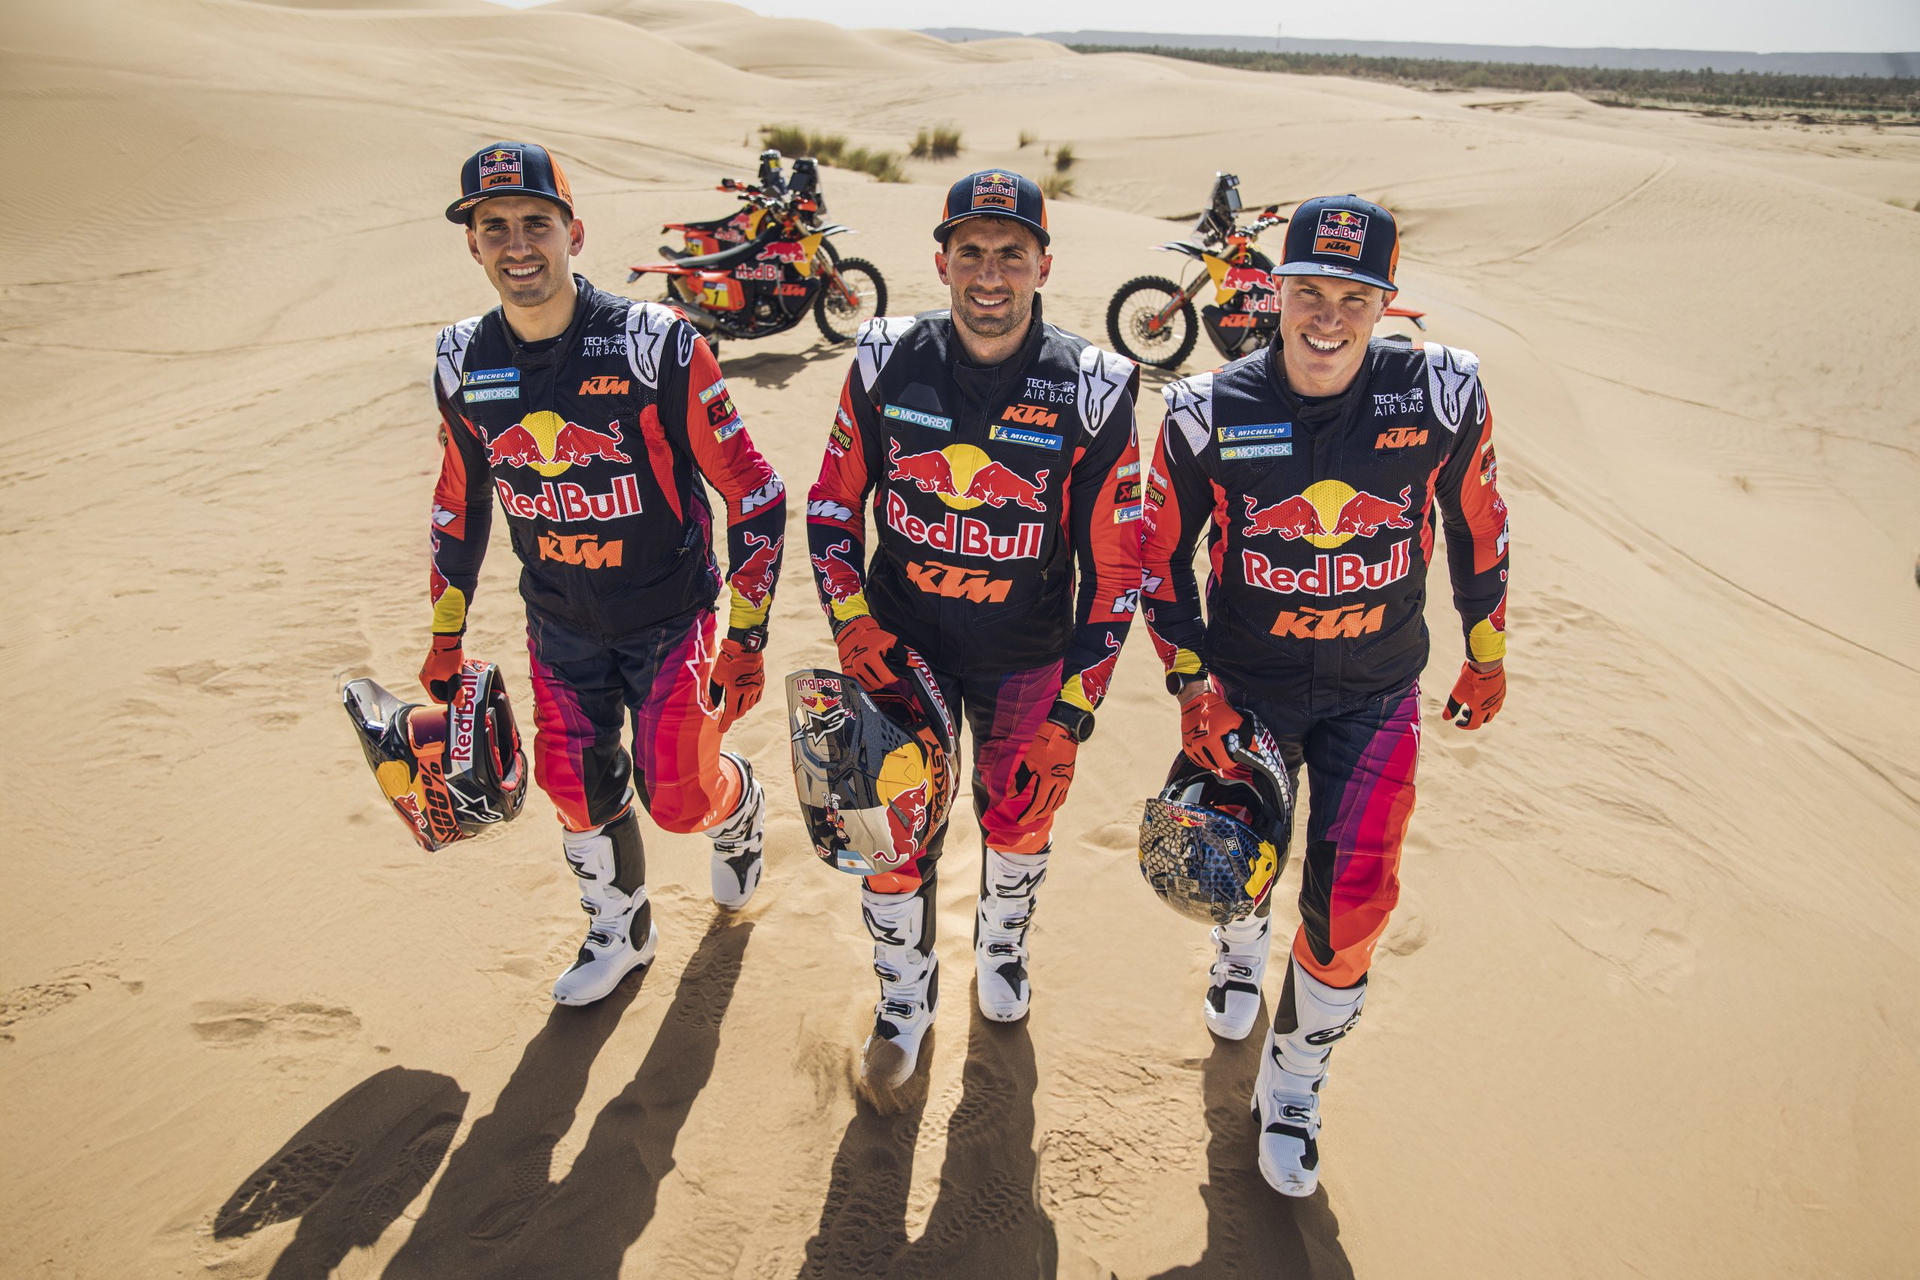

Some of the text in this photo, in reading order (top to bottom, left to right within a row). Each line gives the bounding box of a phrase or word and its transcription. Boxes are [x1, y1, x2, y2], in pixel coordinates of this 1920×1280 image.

[481, 162, 521, 176] Red Bull
[489, 175, 512, 186] KTM
[975, 184, 1016, 197] Red Bull
[982, 196, 1006, 205] KTM
[1318, 225, 1363, 242] Red Bull
[1325, 240, 1351, 253] KTM
[773, 284, 806, 297] KTM
[713, 291, 721, 305] 1
[1242, 293, 1270, 313] Red
[1219, 314, 1258, 328] KTM
[583, 336, 607, 346] TECH
[582, 345, 628, 357] AIR BAG
[476, 371, 514, 381] MICHELIN
[578, 375, 630, 396] KTM
[1026, 377, 1051, 390] TECH
[475, 388, 518, 400] MOTOREX
[1023, 388, 1075, 405] AIR BAG
[1373, 394, 1399, 405] TECH
[1001, 402, 1059, 428] KTM
[1374, 401, 1424, 417] AIR BAG
[900, 408, 950, 430] MOTOREX
[1237, 427, 1285, 437] MICHELIN
[1374, 426, 1429, 450] KTM
[1010, 433, 1057, 447] MICHELIN
[1236, 445, 1289, 458] MOTOREX
[495, 476, 561, 522] Red
[558, 473, 643, 522] Bull
[886, 488, 1045, 562] Red Bull
[537, 530, 624, 570] KTM
[1241, 537, 1412, 598] Red Bull
[905, 560, 1014, 604] KTM
[1269, 603, 1387, 641] KTM
[796, 678, 842, 692] Red Bull
[450, 674, 479, 763] Red Bull
[420, 761, 459, 836] 100%
